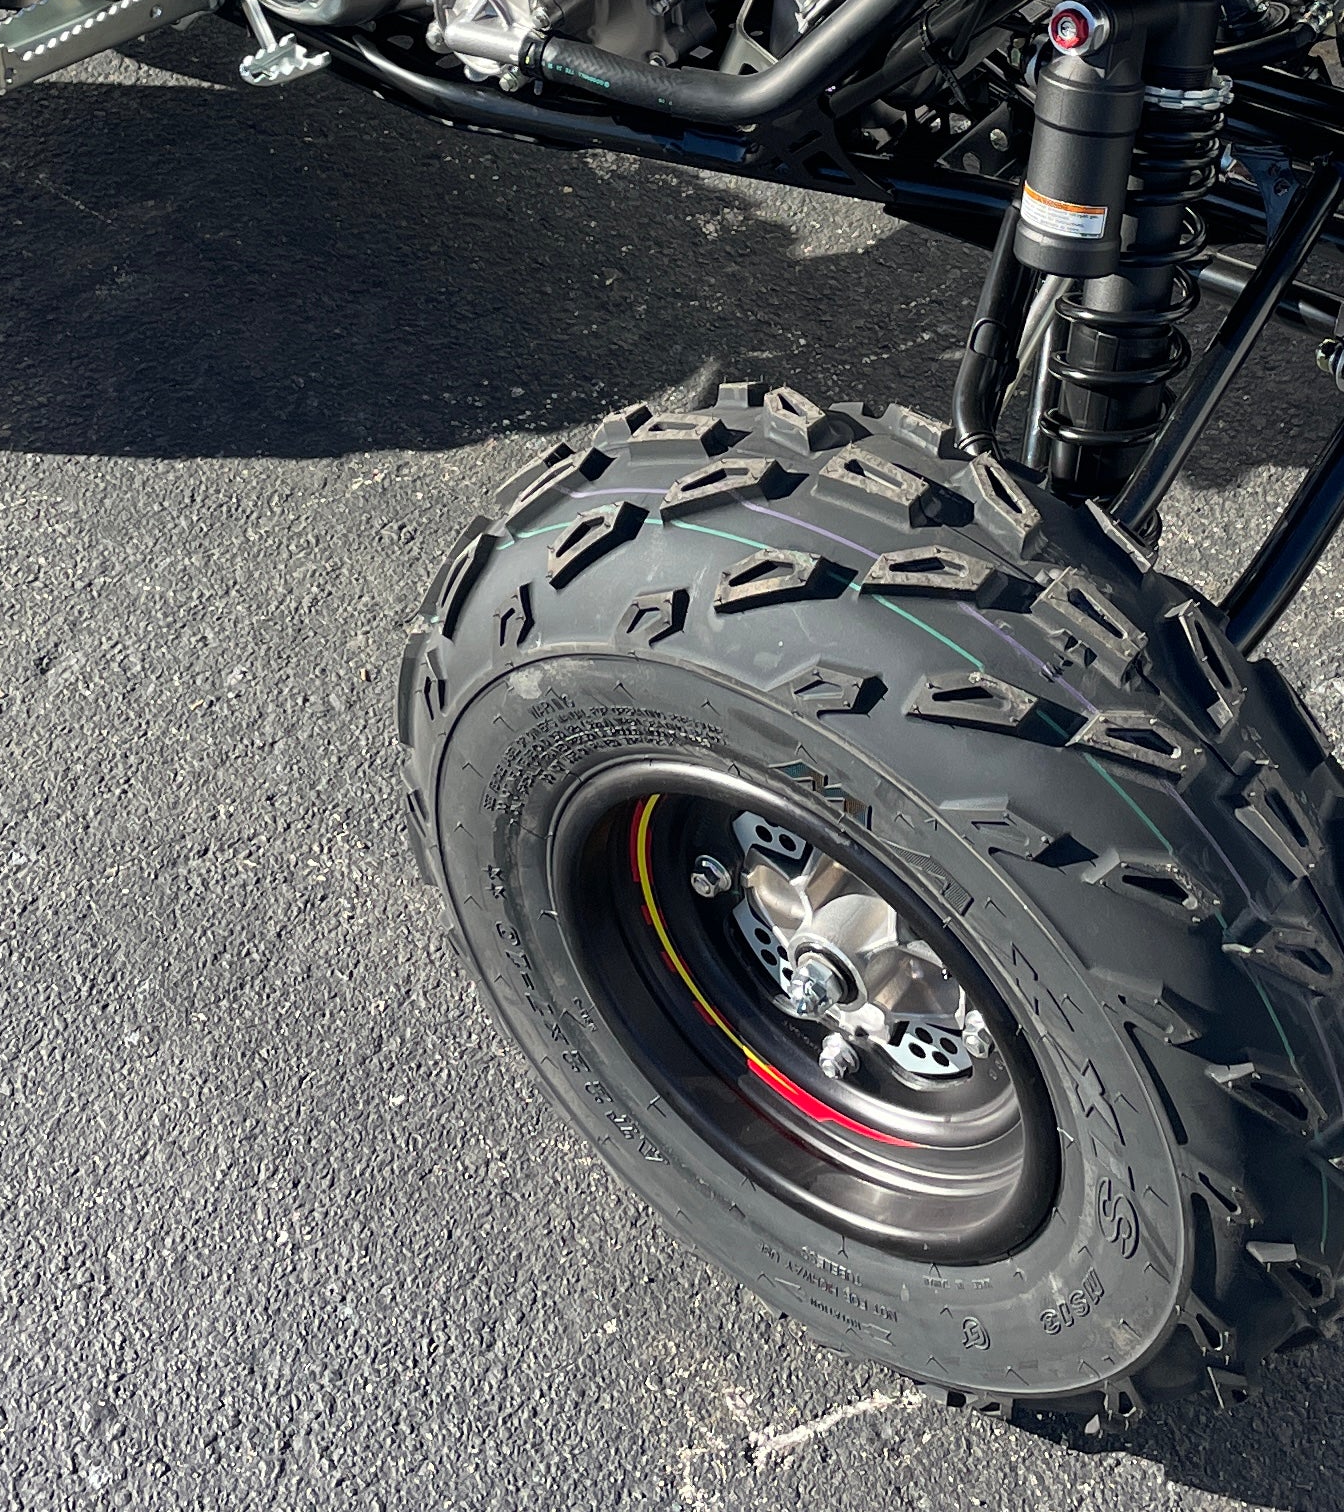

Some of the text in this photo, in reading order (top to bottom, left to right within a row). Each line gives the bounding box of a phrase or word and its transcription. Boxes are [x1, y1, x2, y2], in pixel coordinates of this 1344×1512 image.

[768, 759, 1143, 1262] MAXXIS
[873, 1302, 898, 1323] NOT
[1040, 1266, 1105, 1335] MS13
